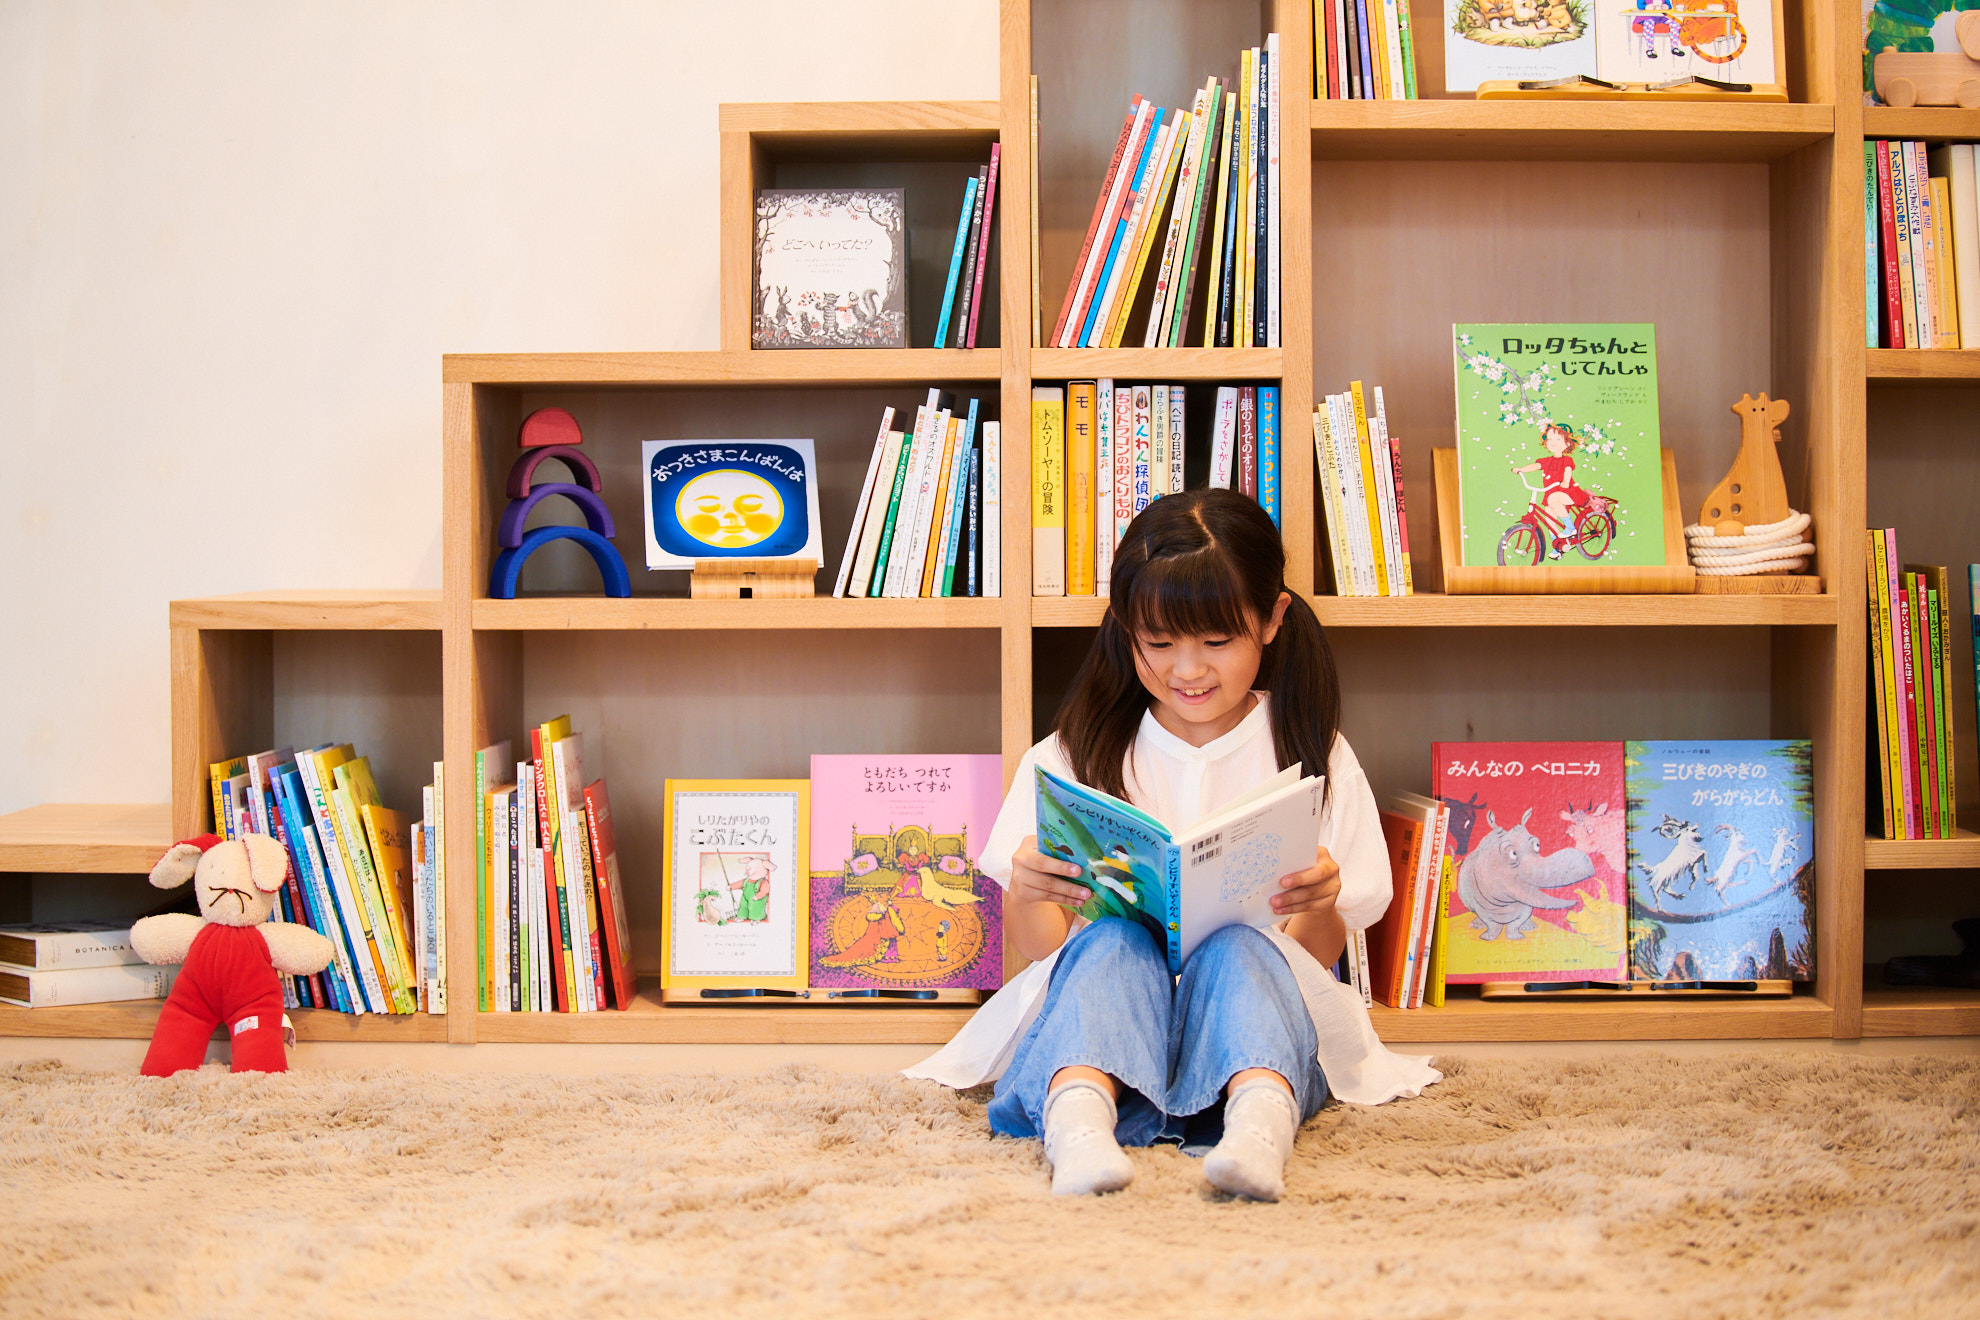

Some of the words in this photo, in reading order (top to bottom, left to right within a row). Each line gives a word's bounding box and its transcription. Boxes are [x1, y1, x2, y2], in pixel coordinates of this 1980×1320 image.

[1135, 149, 1160, 204] よい子への道
[1890, 150, 1907, 242] アルフはひとりぼっち
[972, 209, 982, 224] かめ
[782, 239, 814, 251] どこへ
[819, 239, 873, 251] いってた?
[1502, 337, 1648, 355] ロッタちゃんと
[1561, 361, 1648, 376] じてんしゃ
[1076, 396, 1088, 436] モモ
[987, 431, 995, 462] くんくん
[1171, 407, 1182, 461] ペニーの日記
[1217, 399, 1233, 482] ポーラをさがして
[652, 449, 804, 482] おつきさまこんばんは
[1042, 409, 1053, 515] トム・ソーヤーの冒険
[1115, 393, 1130, 519] ちびドラゴンのおくりもの
[1900, 600, 1912, 683] あかいくるまのついたはこ
[863, 766, 908, 779] ともだち
[915, 766, 952, 779] つれて
[1447, 759, 1524, 777] みんなの
[1531, 761, 1601, 777] ベロニカ
[1662, 762, 1767, 781] 三びきのやぎの
[534, 757, 547, 818] サンタクロースと
[864, 781, 952, 793] よろしいですか
[1691, 788, 1784, 807] がらがらどん
[697, 815, 770, 826] しりたがりやの
[540, 819, 551, 852] 小人たち
[688, 828, 778, 846] こぶたくん
[75, 943, 125, 954] BOTANICA
